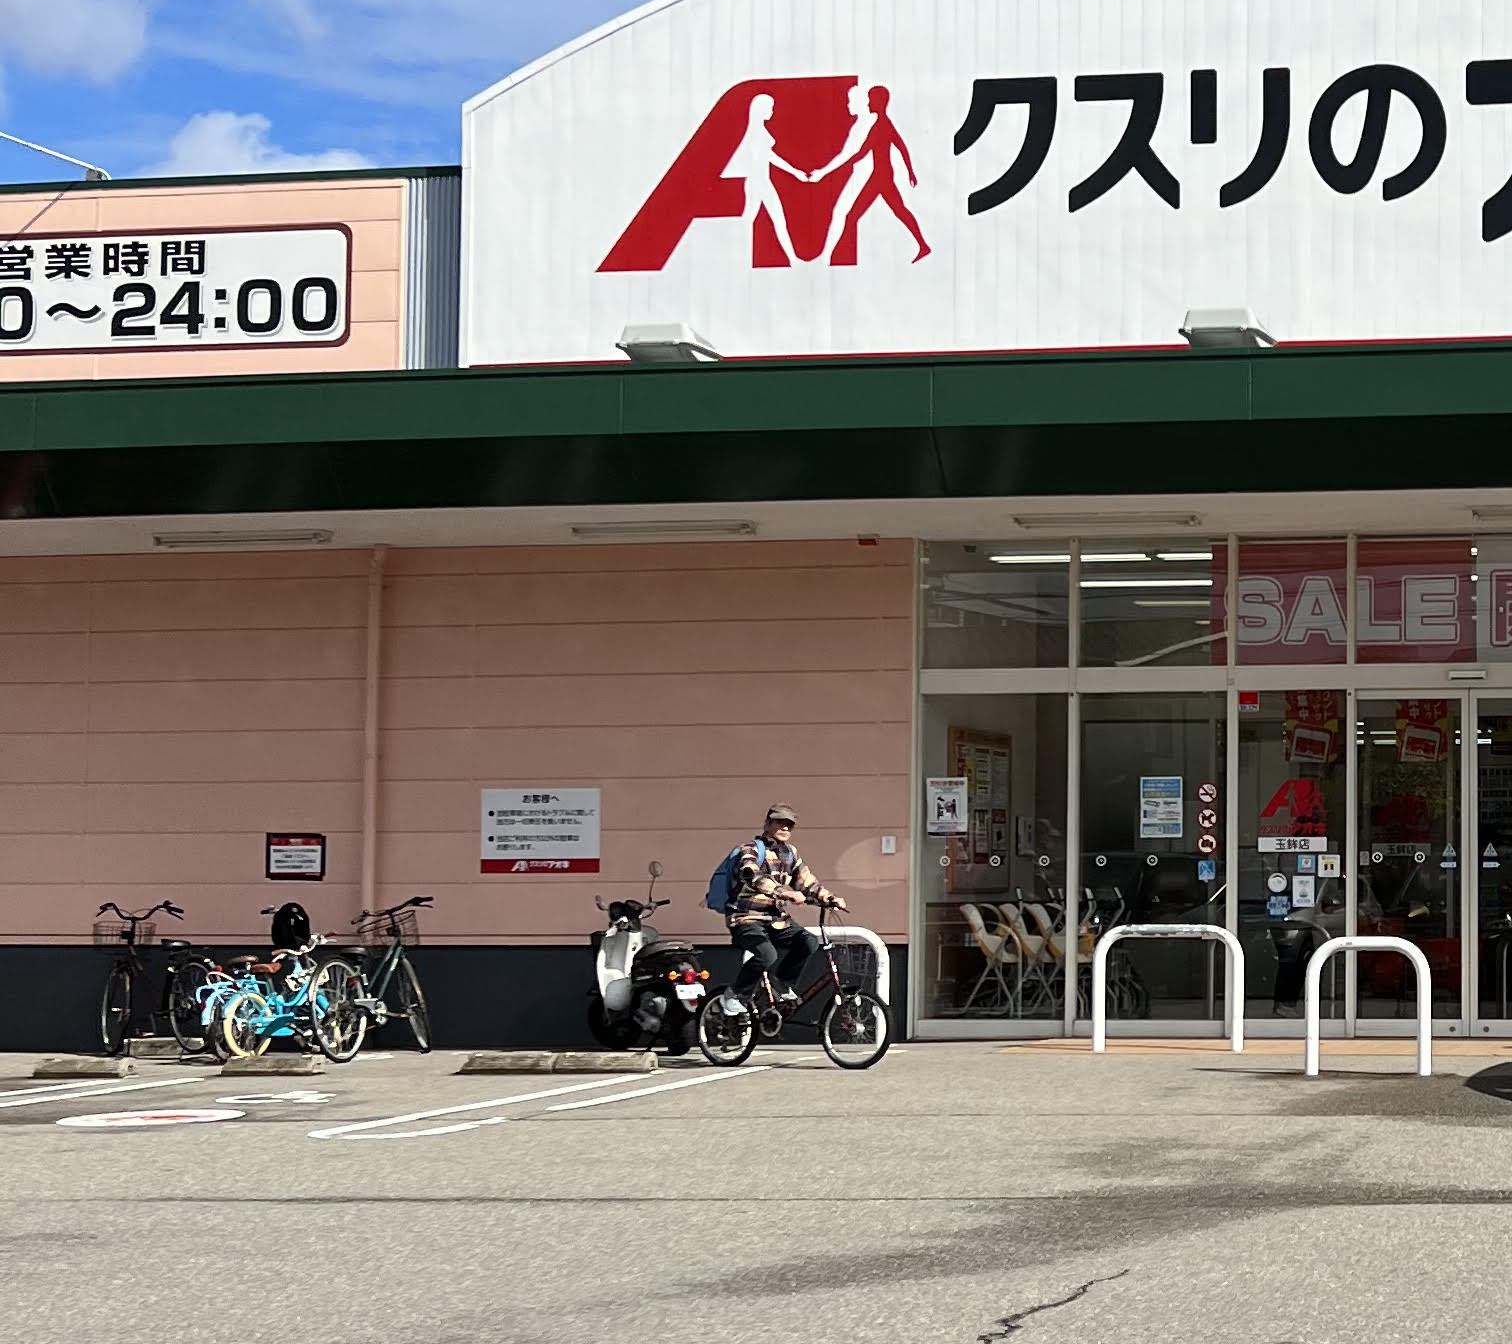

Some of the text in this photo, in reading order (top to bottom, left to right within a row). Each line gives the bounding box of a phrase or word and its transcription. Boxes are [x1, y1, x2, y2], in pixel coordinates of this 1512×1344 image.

[0, 239, 207, 281] 営業時間
[1223, 575, 1460, 647] SALE
[1275, 839, 1310, 851] 玉鉾店
